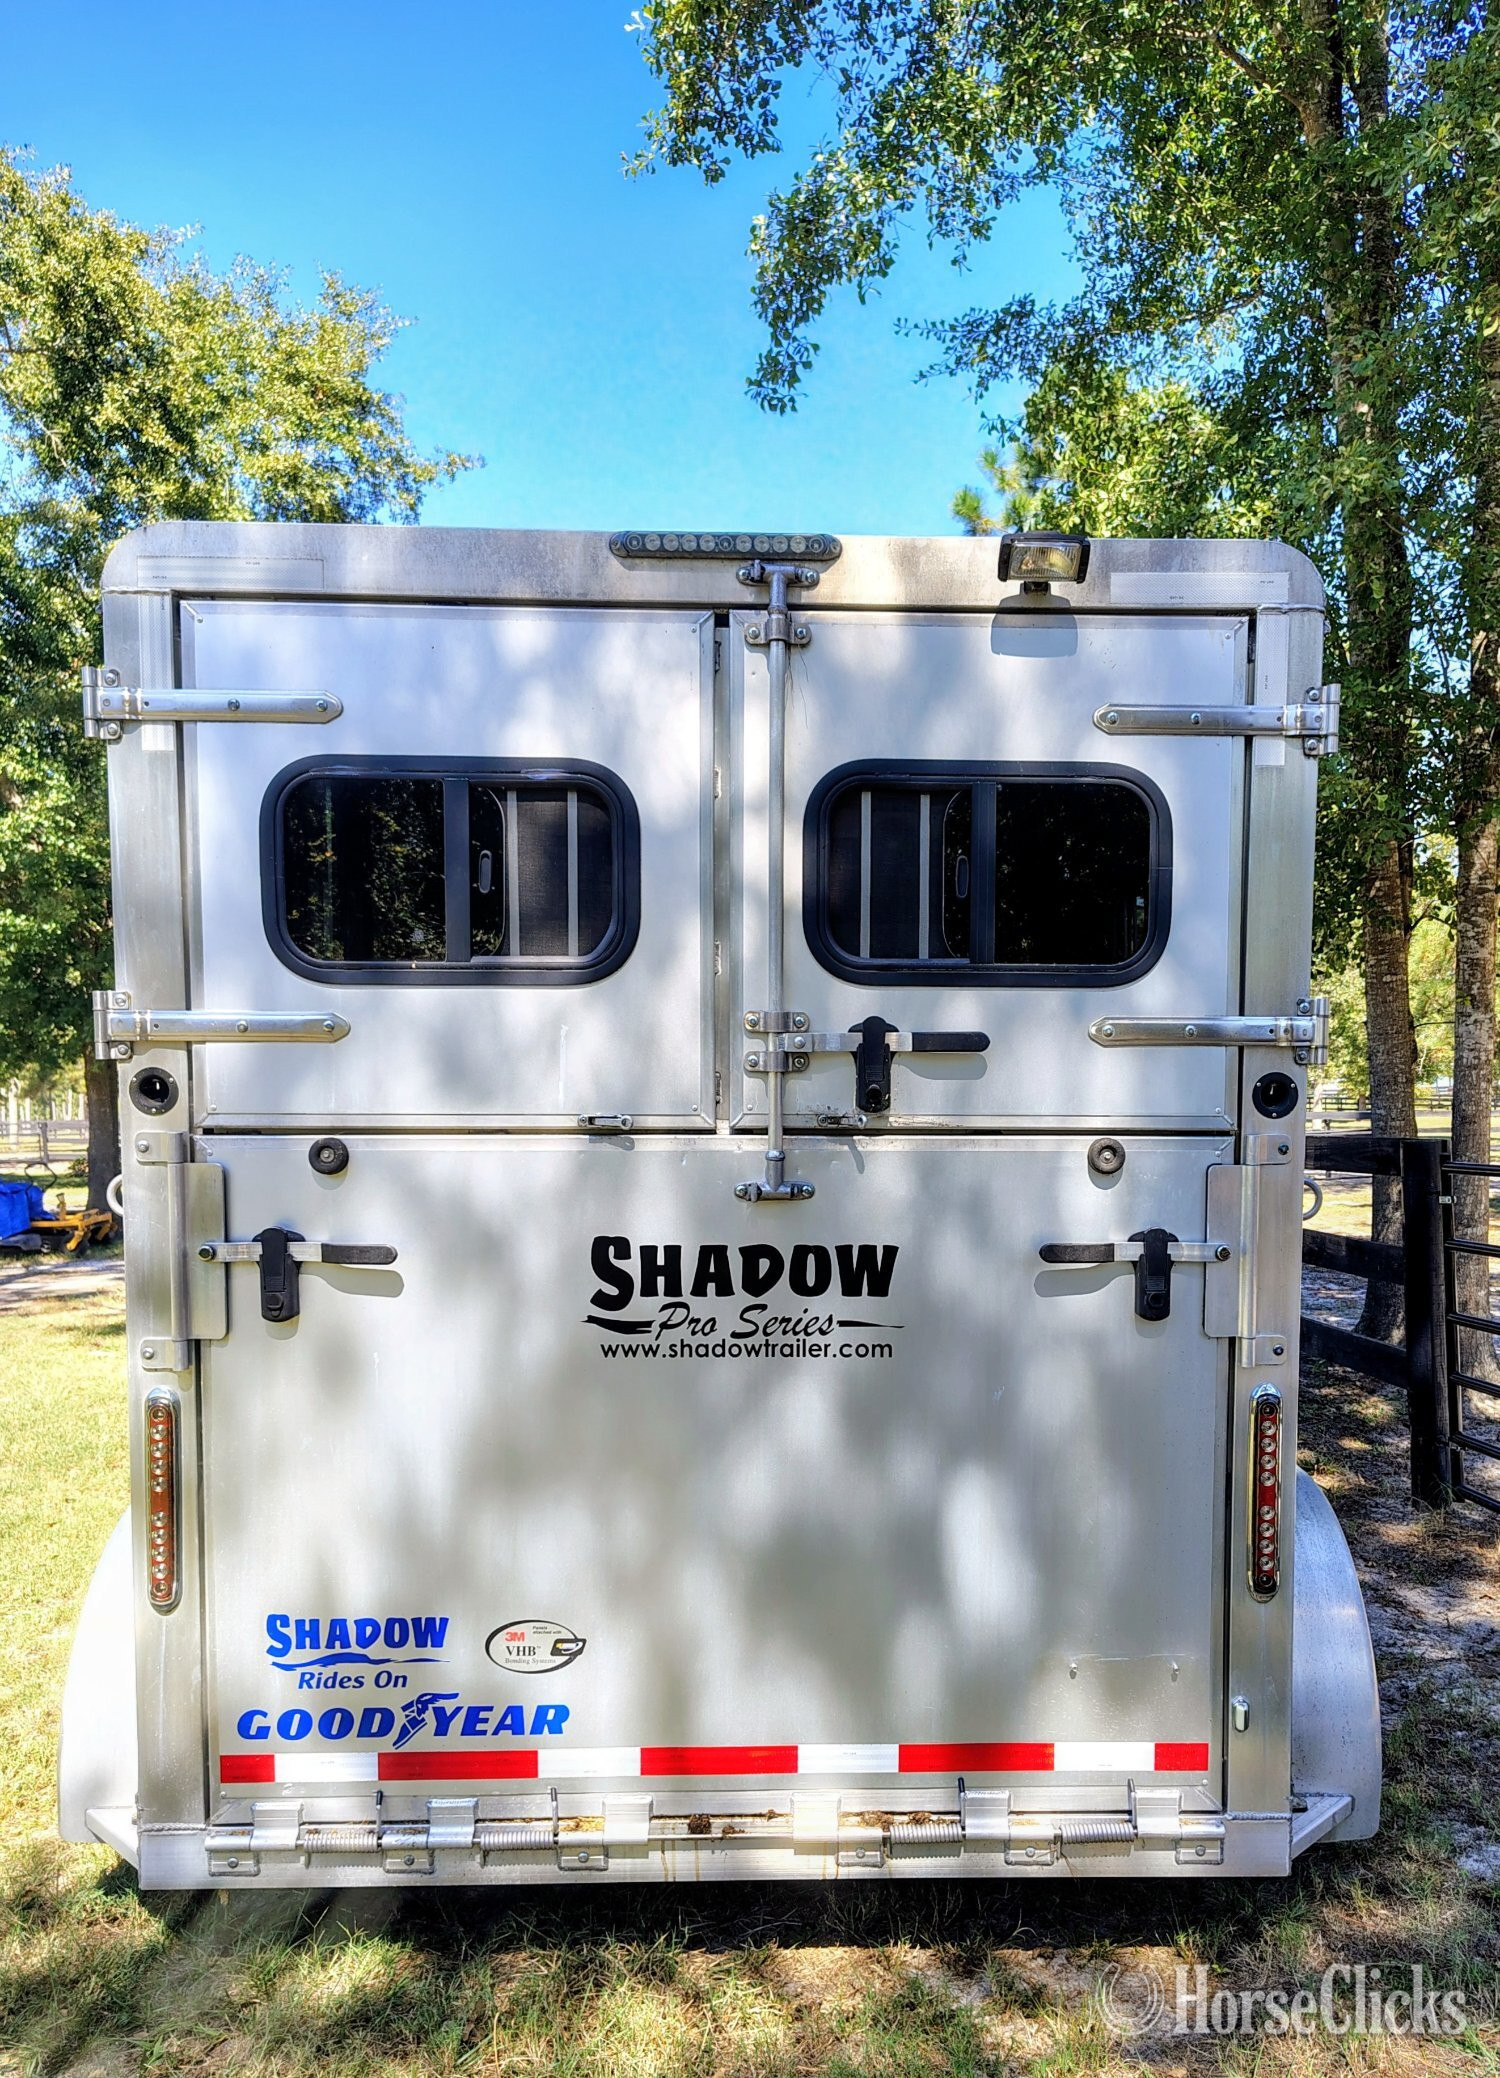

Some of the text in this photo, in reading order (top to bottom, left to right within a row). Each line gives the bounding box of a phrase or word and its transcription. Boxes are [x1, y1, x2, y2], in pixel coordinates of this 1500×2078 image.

[590, 1235, 899, 1312] SHADOW
[654, 1301, 835, 1341] Pro Series
[600, 1338, 893, 1358] www.shadowtrailer.com
[266, 1613, 450, 1658] SHADOW
[504, 1631, 526, 1643] 3M
[504, 1657, 531, 1665] Bonding
[298, 1670, 409, 1690] Rides On
